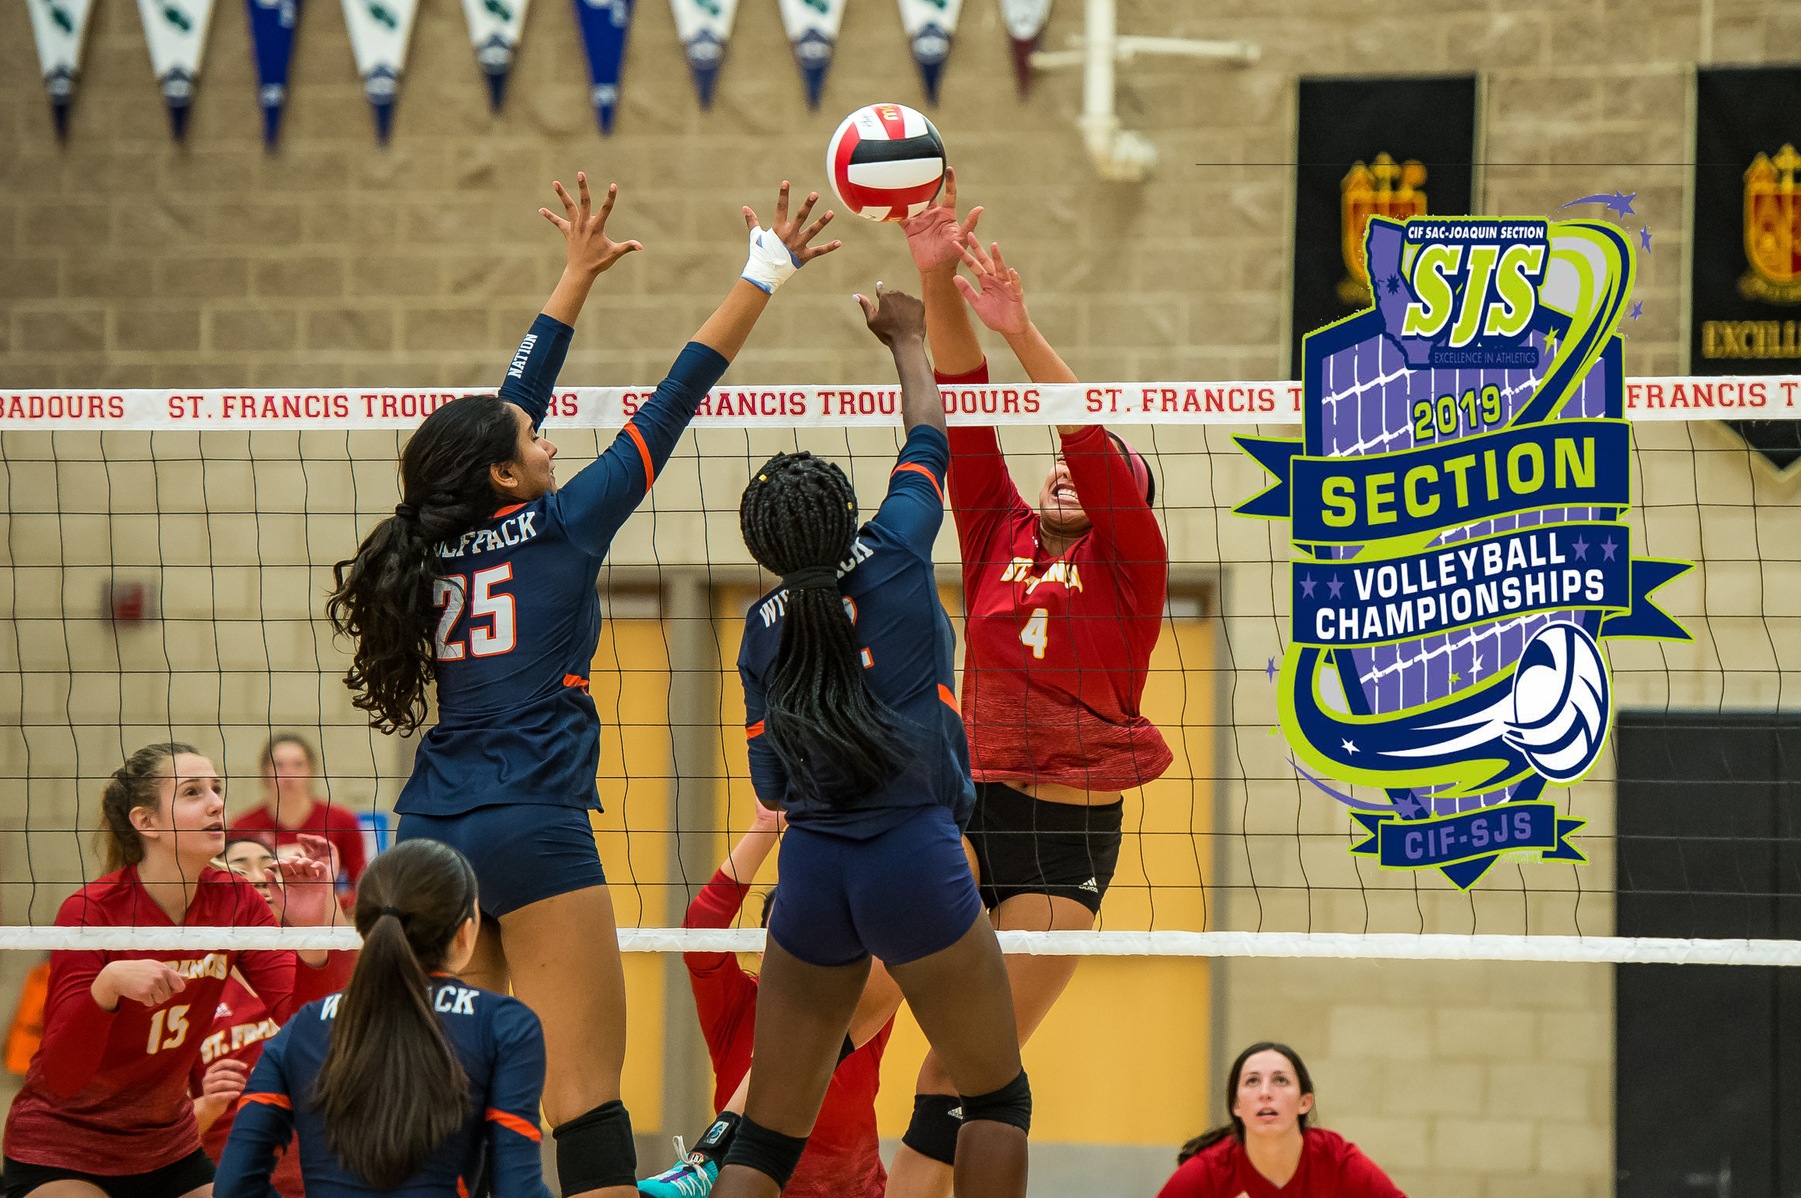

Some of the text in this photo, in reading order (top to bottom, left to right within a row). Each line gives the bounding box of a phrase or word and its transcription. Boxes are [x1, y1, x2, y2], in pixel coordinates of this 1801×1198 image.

[508, 333, 538, 379] NATION
[0, 396, 124, 418] ADOURS
[168, 395, 212, 418] ST.
[222, 395, 348, 418] FRANCIS
[696, 392, 806, 416] RANCIS
[817, 388, 1040, 416] TROUDOURS
[1086, 388, 1132, 413] ST.
[1143, 387, 1275, 413] FRANCIS
[1627, 383, 1767, 409] FRANCIS
[432, 561, 517, 662] 25
[1019, 608, 1048, 659] 4
[146, 1004, 190, 1055] 15
